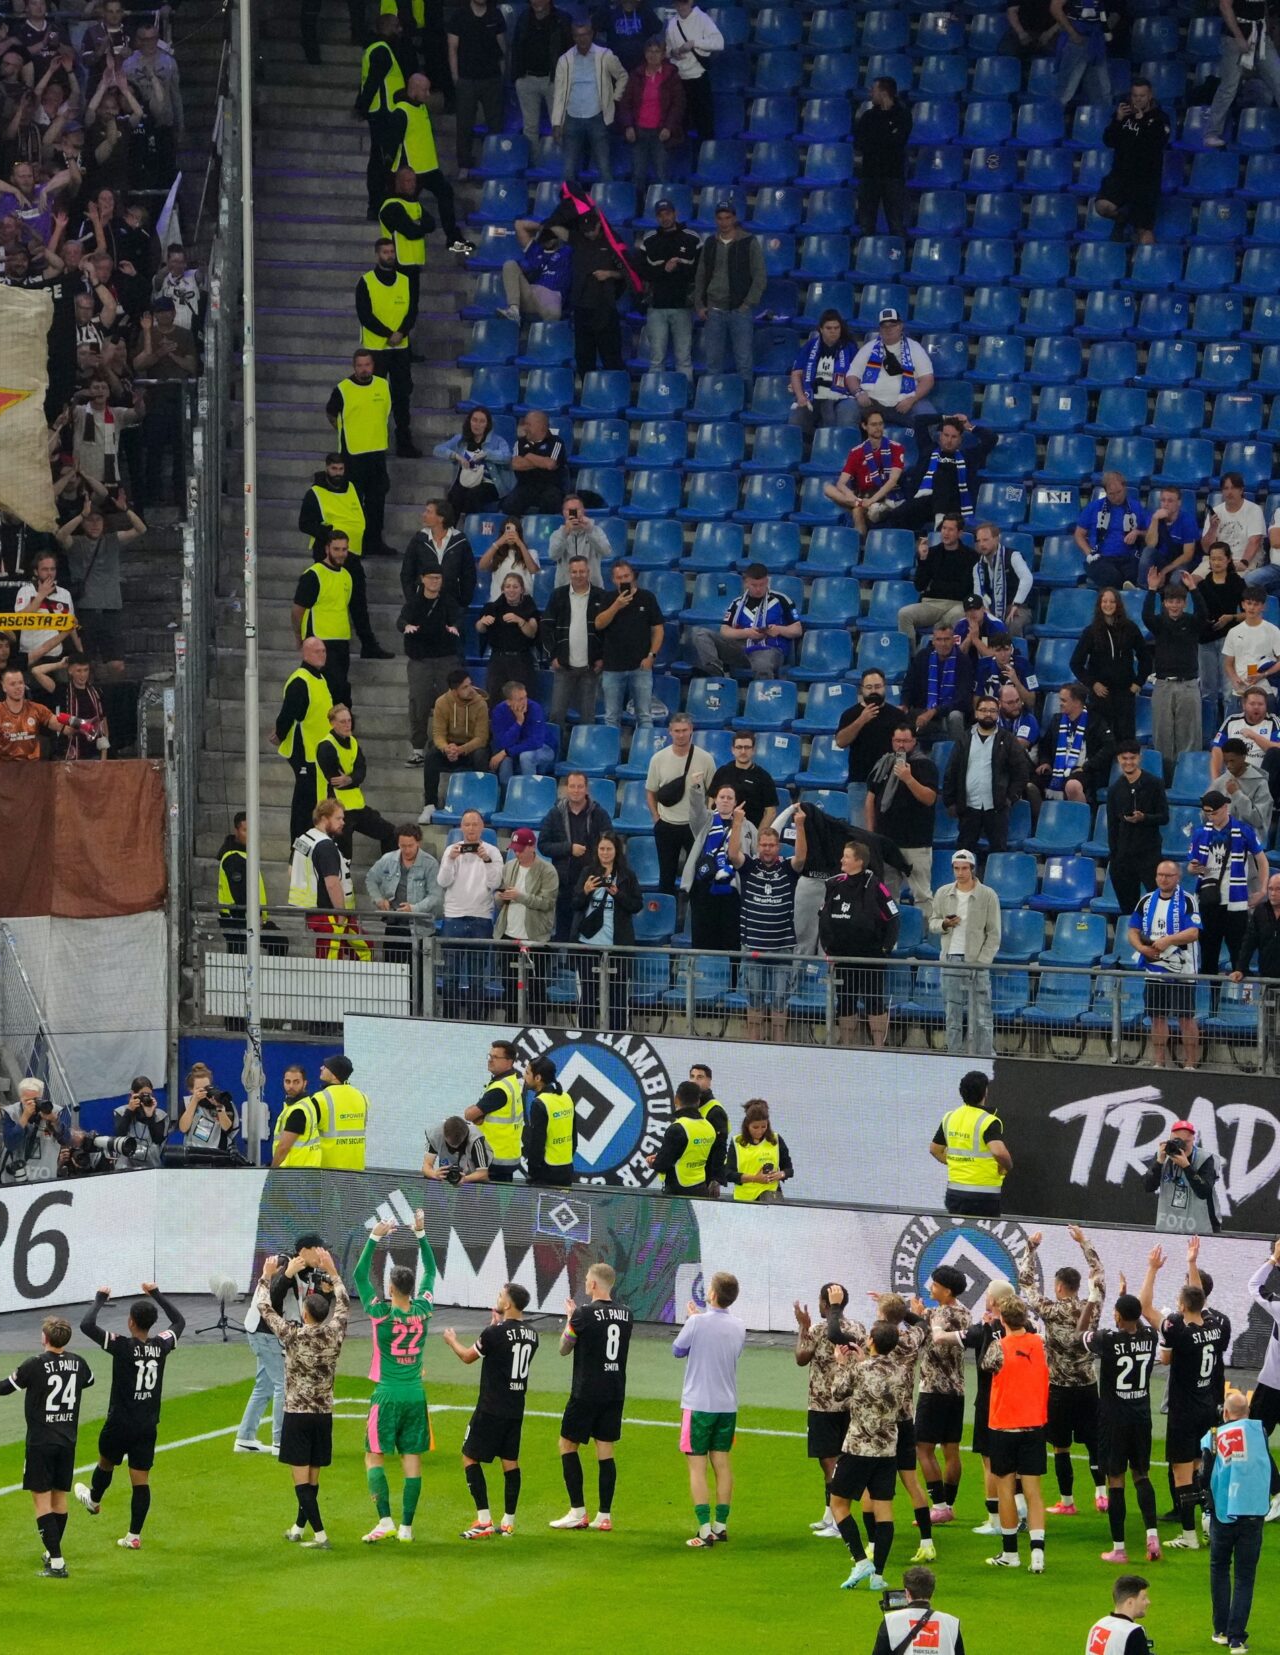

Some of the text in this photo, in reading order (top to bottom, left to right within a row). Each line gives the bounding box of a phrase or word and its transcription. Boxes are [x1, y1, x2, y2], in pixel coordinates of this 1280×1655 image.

[1049, 1085, 1280, 1218] TRAD
[1157, 1212, 1197, 1230] FOTO
[594, 1308, 629, 1322] ST. PAULI
[391, 1322, 424, 1356] 22
[506, 1328, 536, 1342] ST. PAULI
[606, 1323, 621, 1361] 8
[1114, 1339, 1153, 1356] ST. PAULI
[1193, 1332, 1205, 1344] ST.
[44, 1360, 79, 1373] ST. PAULI
[511, 1343, 532, 1379] 10
[1116, 1353, 1152, 1390] 27
[1200, 1344, 1215, 1378] 6
[45, 1373, 77, 1411] 24
[45, 1412, 74, 1423] METCALFE
